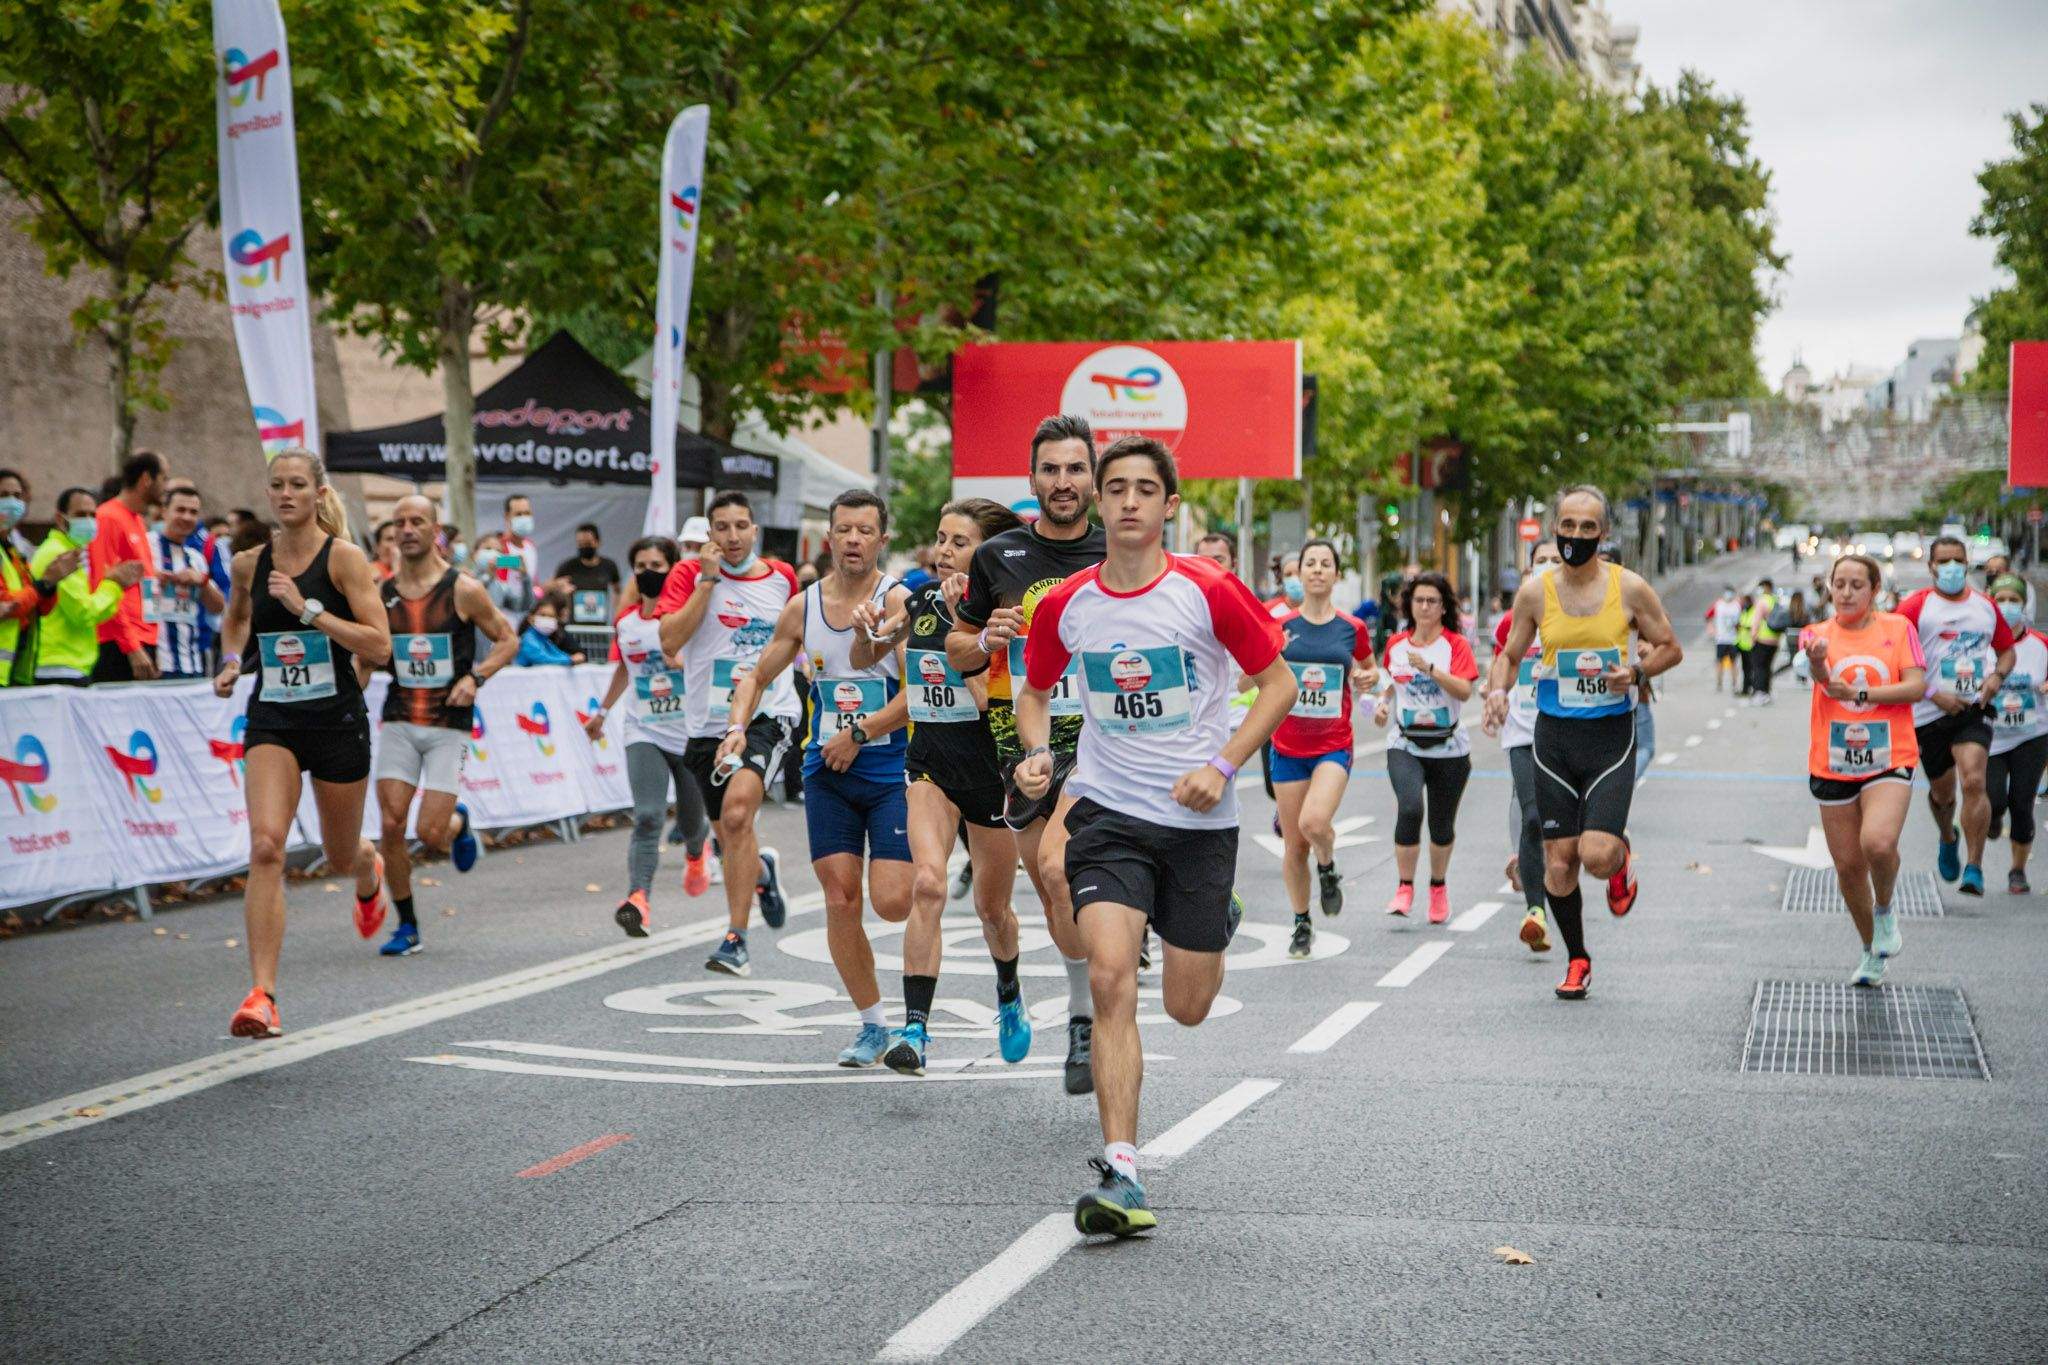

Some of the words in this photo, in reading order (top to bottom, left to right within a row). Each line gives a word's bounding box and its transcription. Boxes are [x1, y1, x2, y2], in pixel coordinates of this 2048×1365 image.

[280, 666, 311, 687] 421
[408, 661, 436, 677] 430
[1576, 678, 1607, 694] 458
[650, 695, 682, 714] 1222
[923, 686, 955, 707] 460
[1114, 691, 1163, 719] 465
[1299, 690, 1327, 707] 445
[1844, 749, 1874, 765] 454
